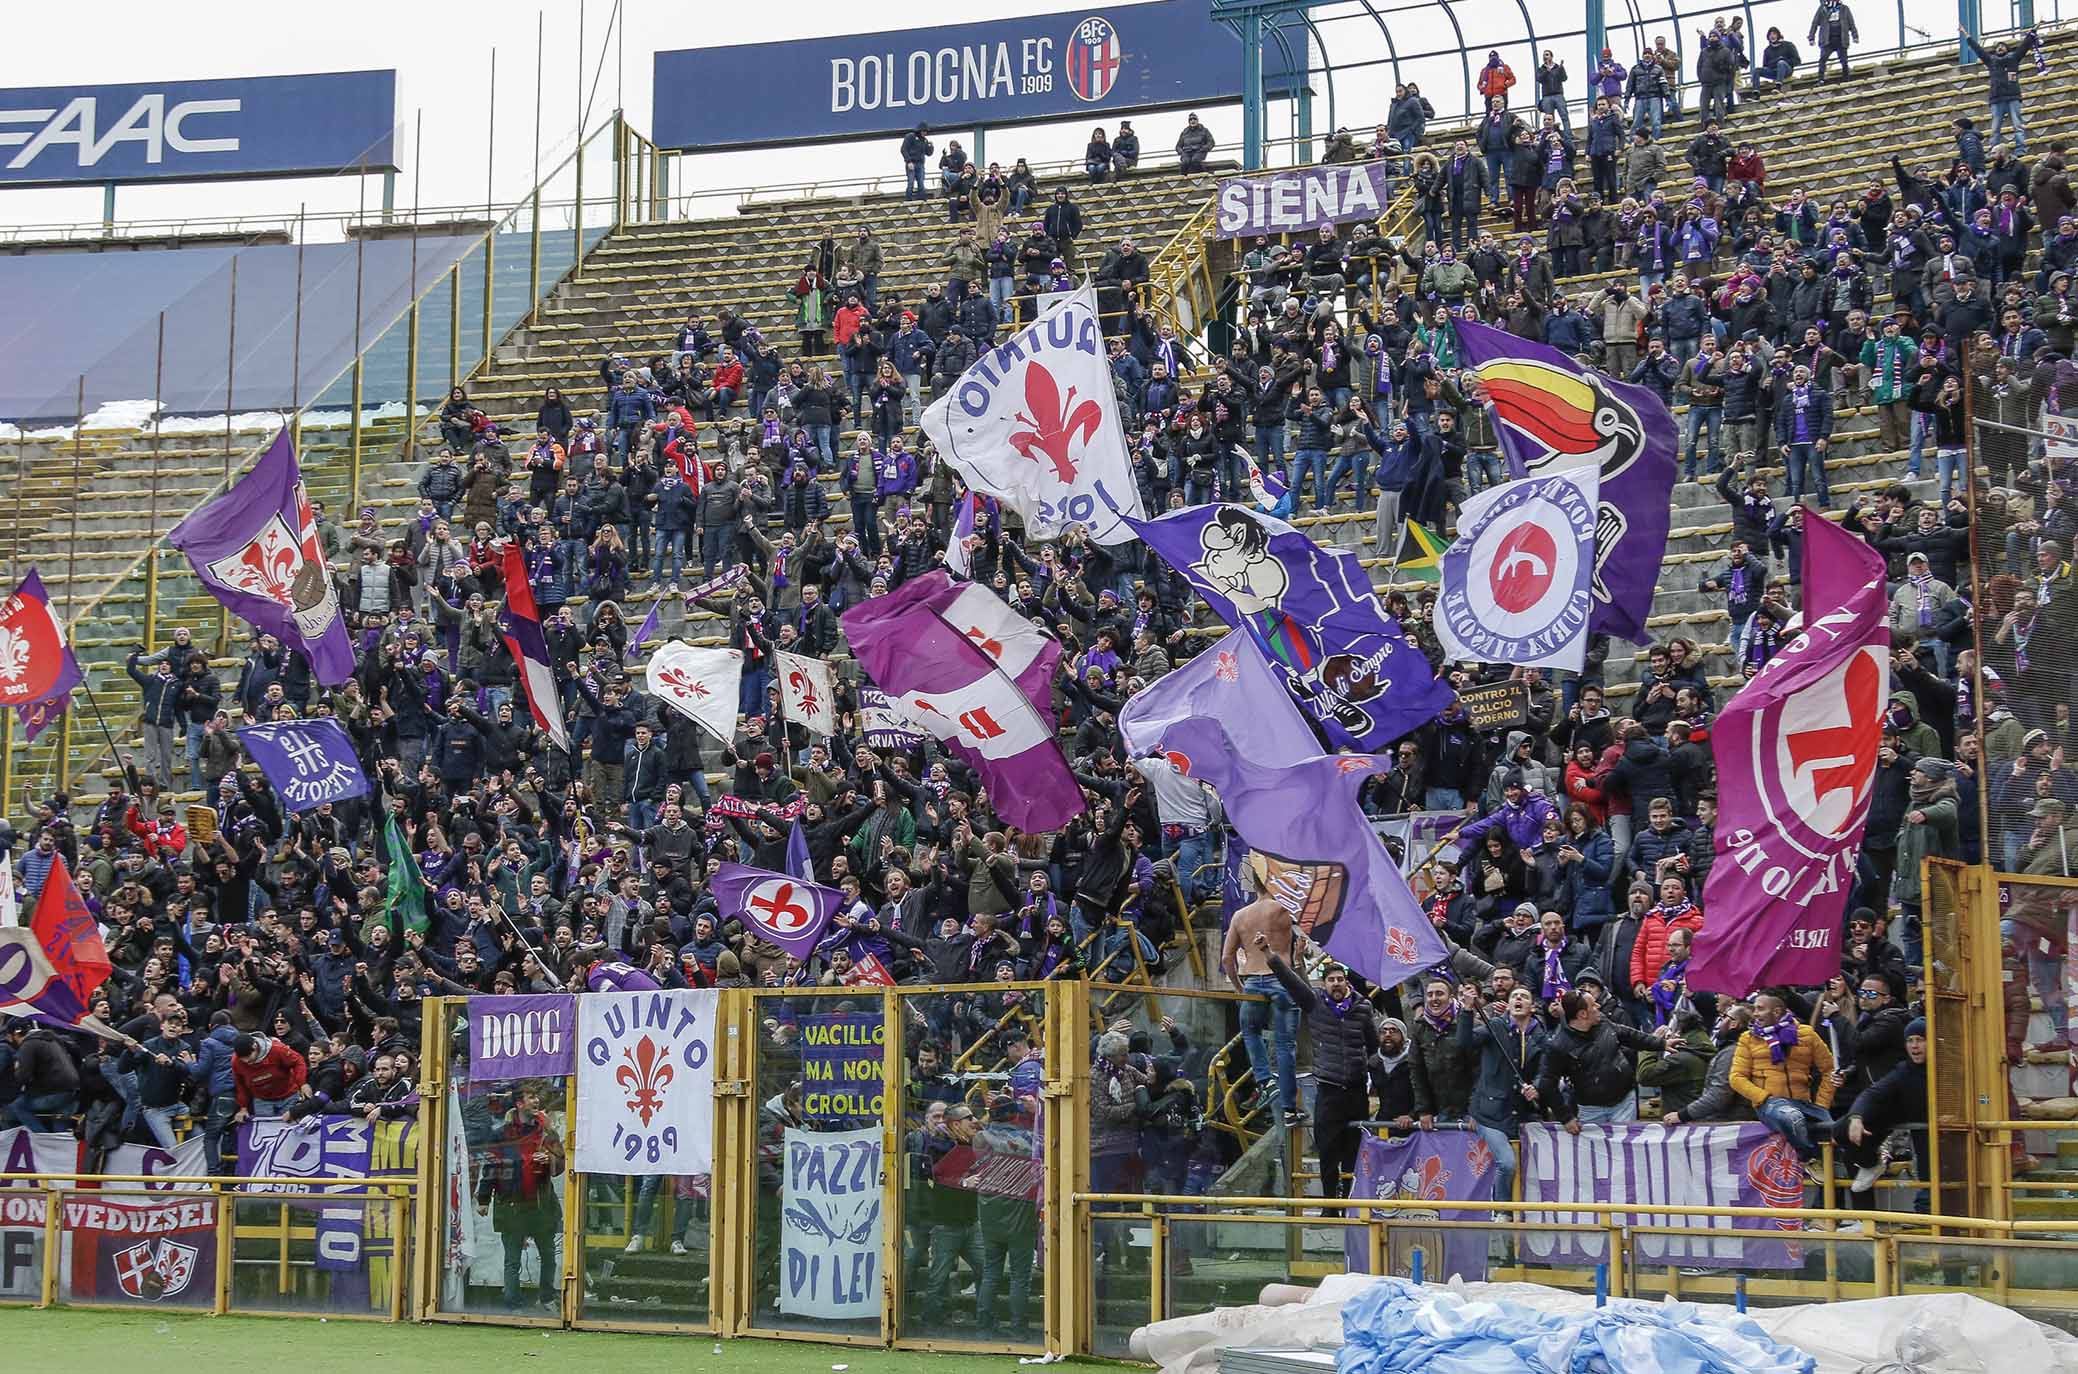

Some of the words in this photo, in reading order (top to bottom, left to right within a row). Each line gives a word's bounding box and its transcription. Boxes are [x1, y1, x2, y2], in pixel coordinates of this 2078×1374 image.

[1080, 20, 1106, 38] BFC
[831, 41, 1015, 112] BOLOGNA
[1022, 37, 1053, 74] FC
[1021, 74, 1052, 95] 1909
[1220, 166, 1380, 231] SIENA
[1460, 689, 1507, 703] CONTRO
[1510, 687, 1521, 695] IL
[1471, 699, 1512, 714] CALCIO
[1471, 710, 1520, 725] ODERNO
[480, 1009, 562, 1060] DOCG
[587, 993, 708, 1069] QUINTO
[805, 1061, 833, 1081] MA
[843, 1060, 884, 1081] NON
[805, 1094, 884, 1115] CROLLO
[613, 1122, 678, 1163] 1989
[789, 1140, 881, 1195] PAZZI
[788, 1247, 819, 1301] DI
[833, 1252, 875, 1305] LEI
